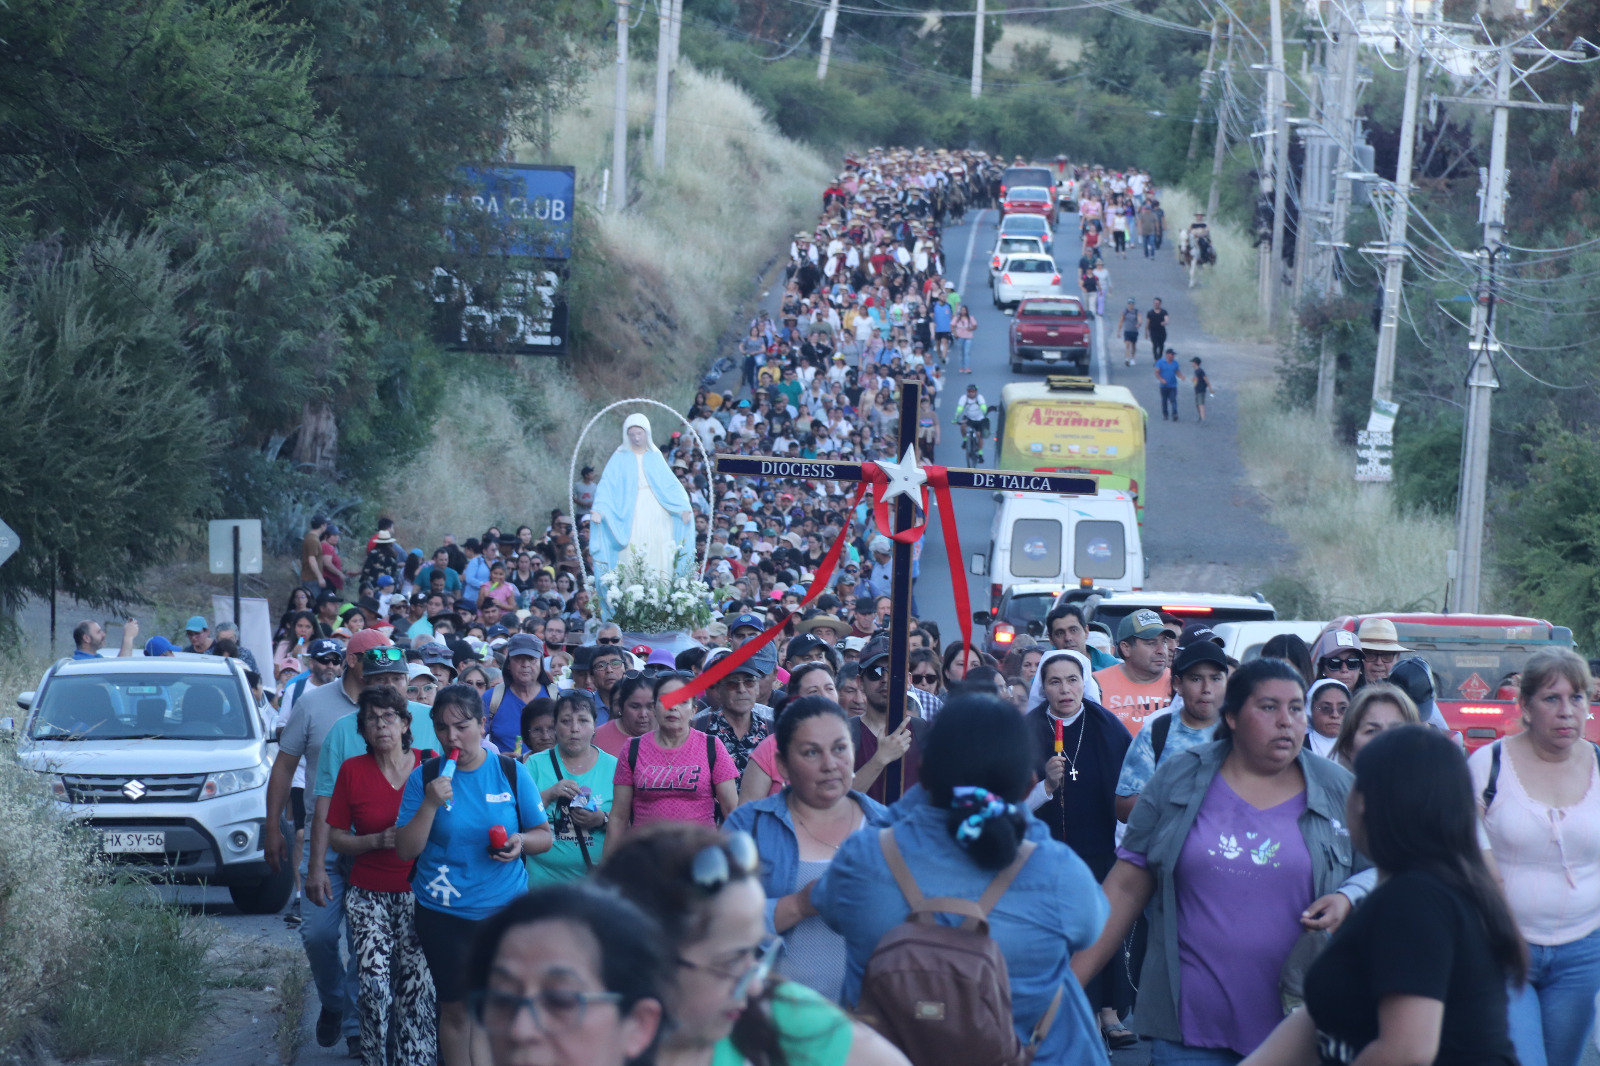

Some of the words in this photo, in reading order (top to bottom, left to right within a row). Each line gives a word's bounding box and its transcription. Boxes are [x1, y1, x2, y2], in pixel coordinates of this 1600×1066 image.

[761, 461, 835, 478] DIOCESIS
[973, 473, 995, 487] DE
[1000, 475, 1052, 491] TALCA
[637, 764, 701, 791] NIKE
